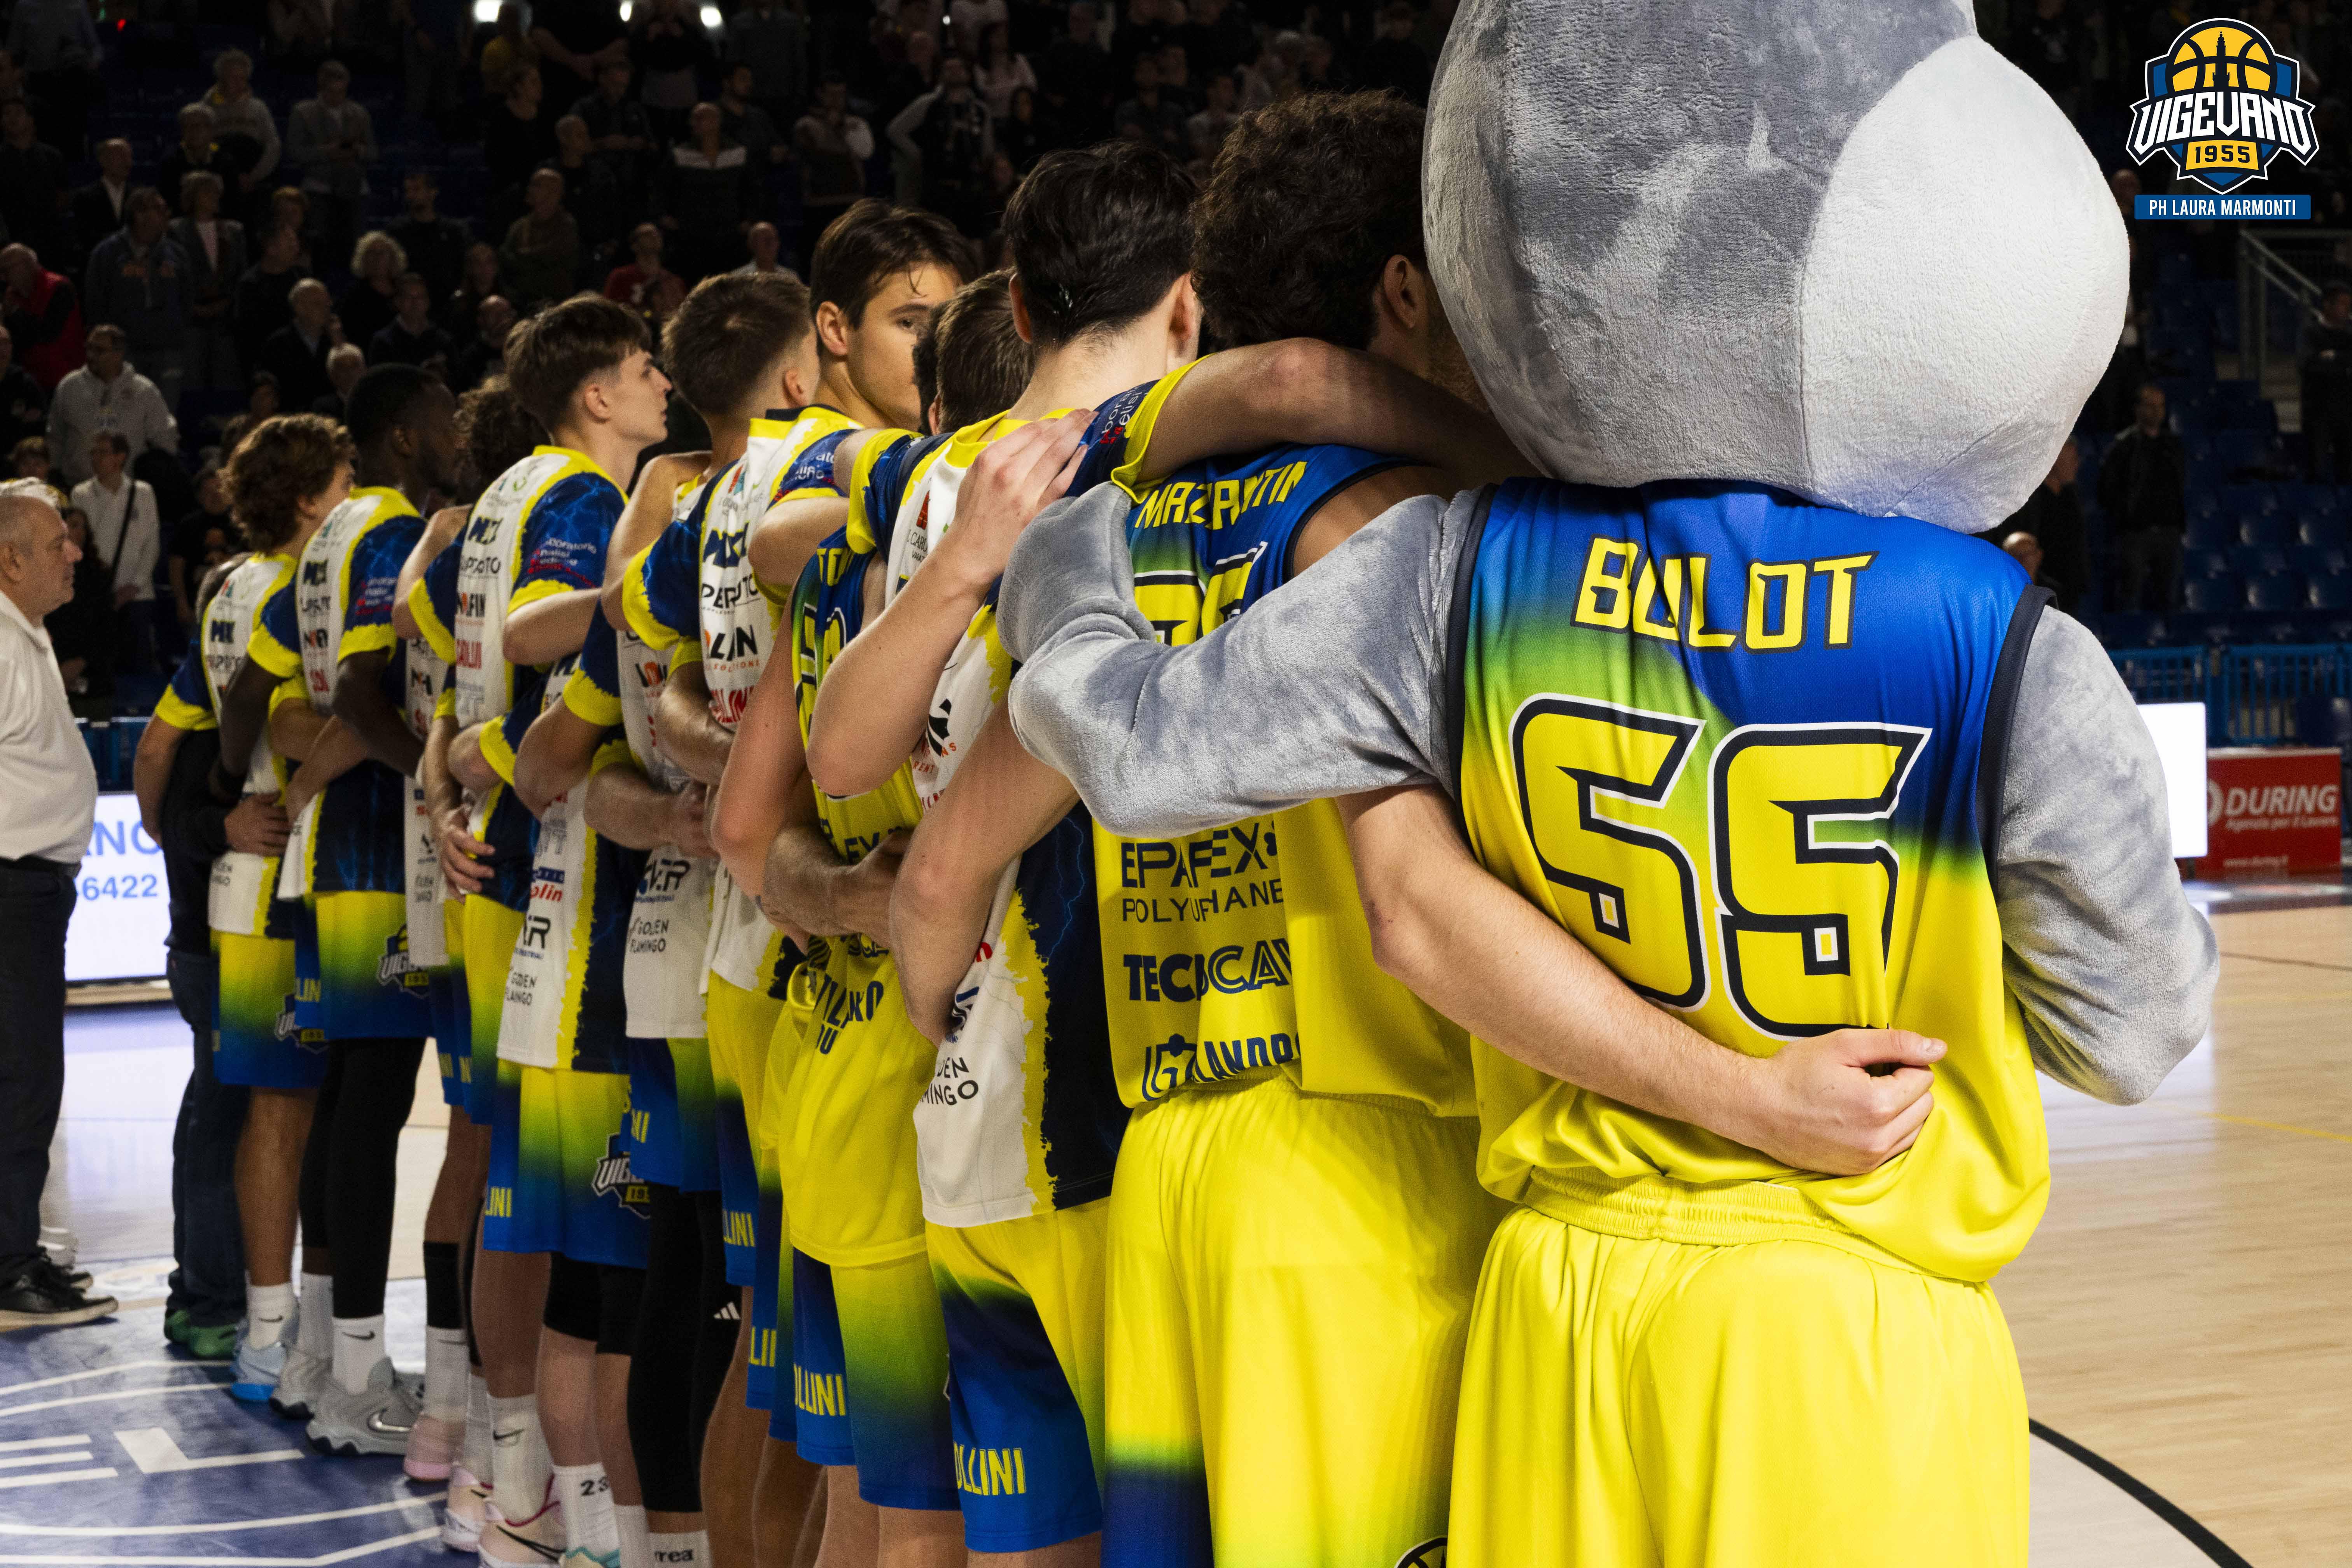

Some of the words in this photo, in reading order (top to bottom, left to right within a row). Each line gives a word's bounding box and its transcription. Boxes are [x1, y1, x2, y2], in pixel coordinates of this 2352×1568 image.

[2225, 784, 2339, 815] DURING
[1508, 693, 1932, 1040] 55
[82, 874, 158, 901] 6422
